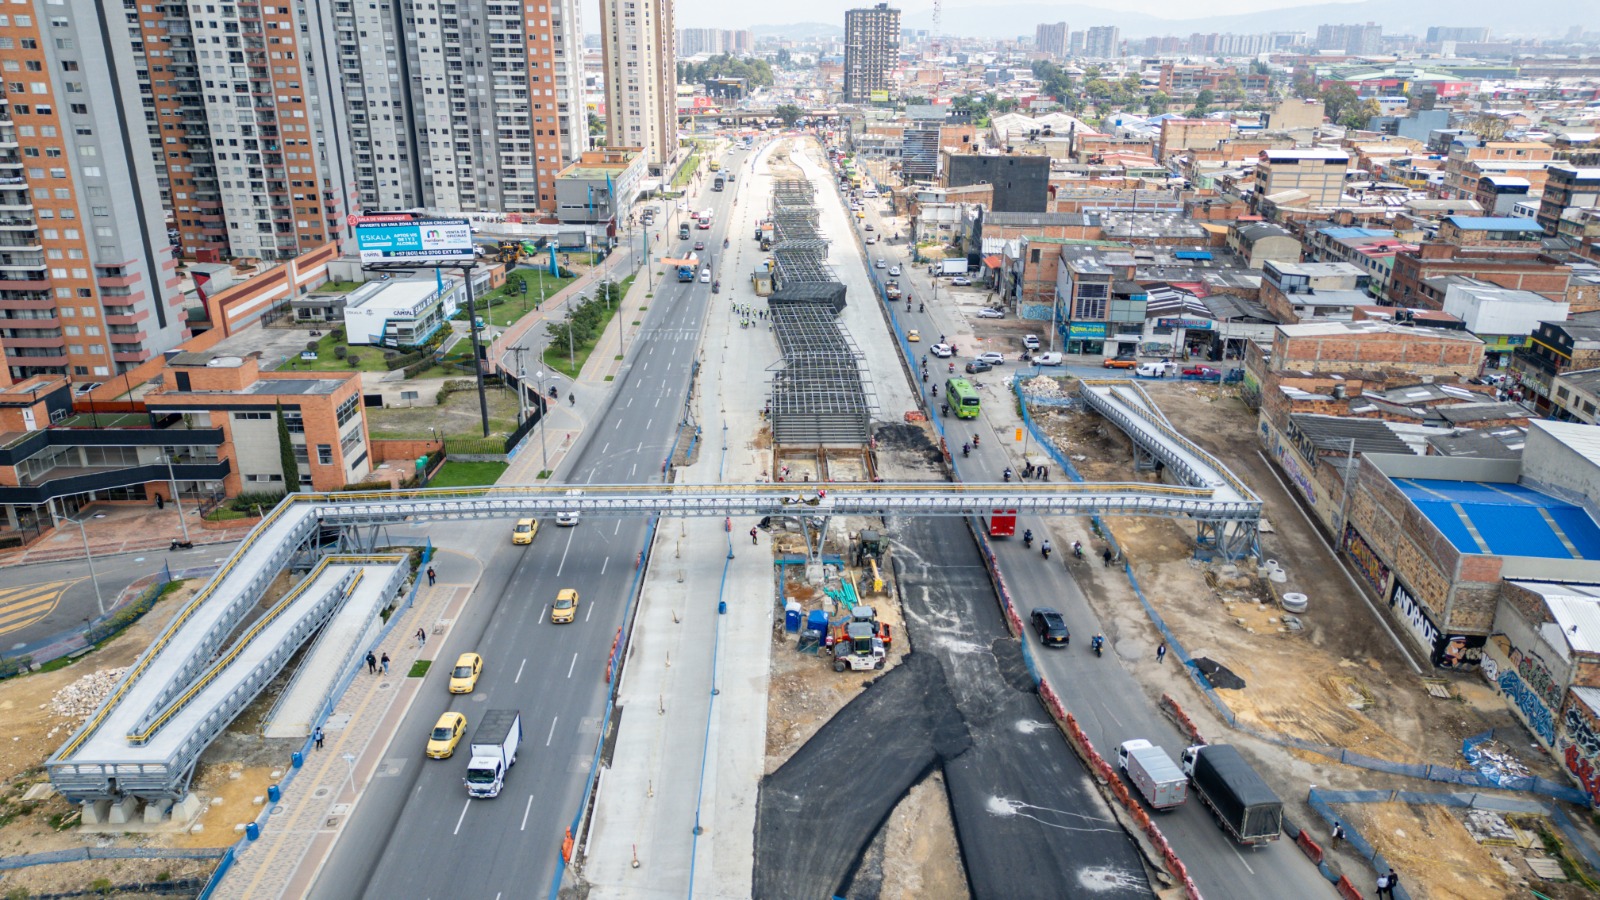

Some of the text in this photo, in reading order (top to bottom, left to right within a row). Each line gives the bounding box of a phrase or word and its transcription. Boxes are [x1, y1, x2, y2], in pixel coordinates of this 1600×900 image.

[414, 301, 427, 315] SALA
[426, 297, 433, 306] DE
[1393, 586, 1439, 652] ANDRADE
